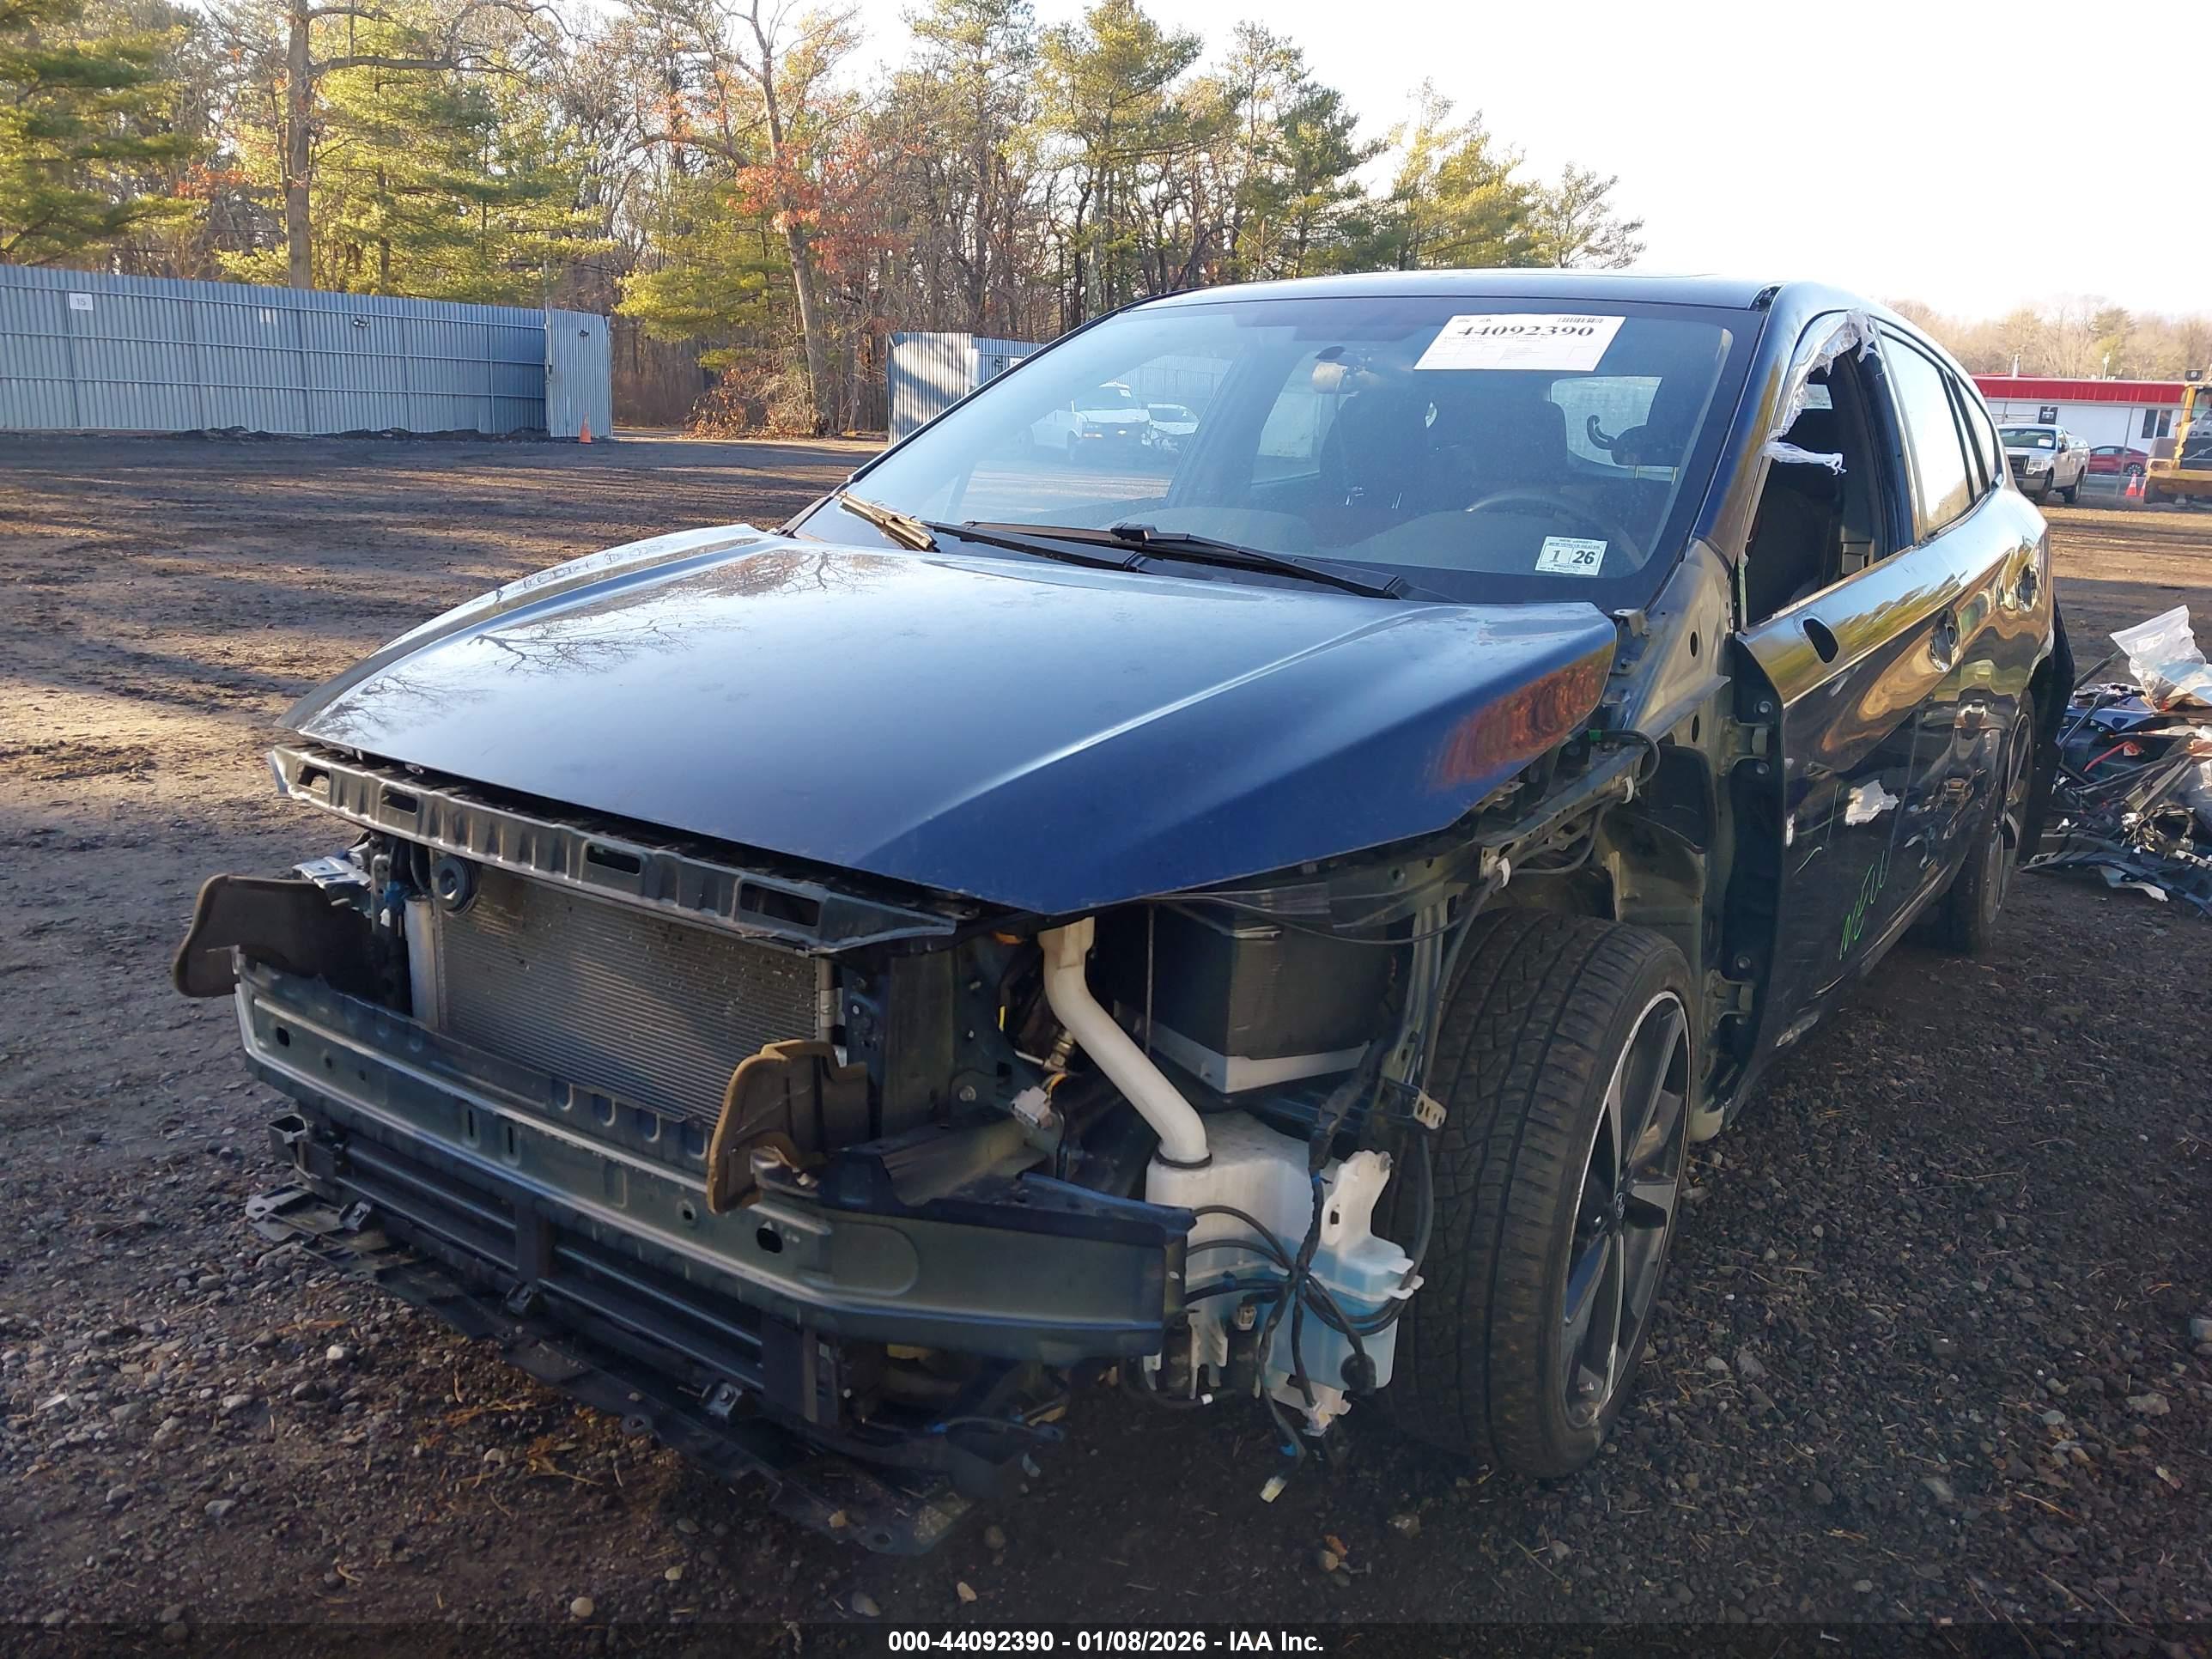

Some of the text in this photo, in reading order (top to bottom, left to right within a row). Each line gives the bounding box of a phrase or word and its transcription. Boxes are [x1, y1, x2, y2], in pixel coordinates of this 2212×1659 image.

[1457, 325, 1595, 336] 44092390
[1549, 550, 1596, 565] 1 26
